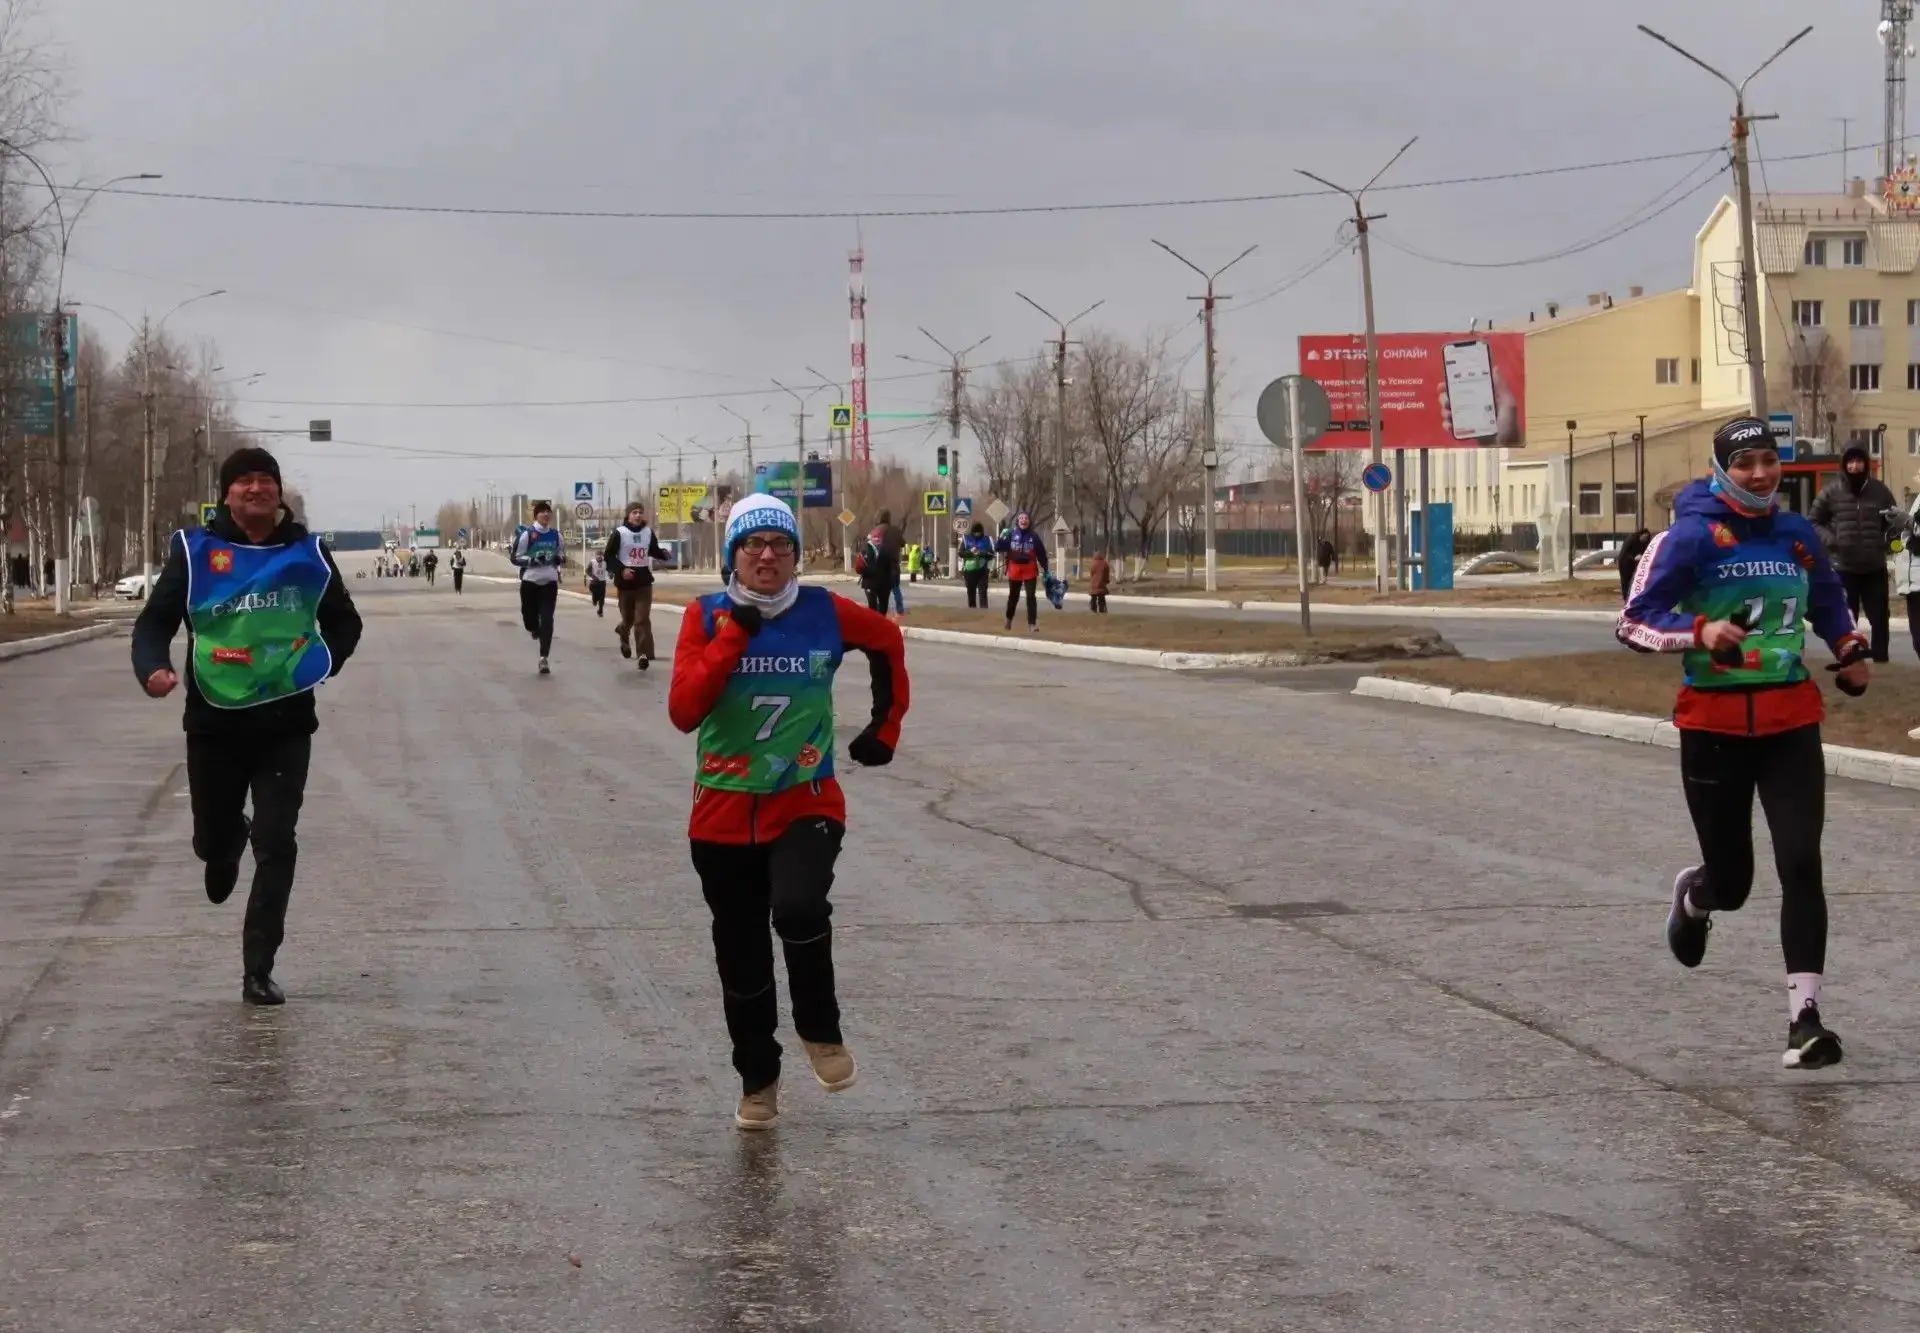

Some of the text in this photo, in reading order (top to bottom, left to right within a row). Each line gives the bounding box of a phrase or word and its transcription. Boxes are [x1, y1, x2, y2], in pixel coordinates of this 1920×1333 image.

[1383, 347, 1427, 359] ОНЛАЙН
[579, 507, 590, 515] 20
[956, 520, 968, 529] 20
[629, 547, 645, 559] 40
[1717, 560, 1799, 579] УСИНСК
[1744, 595, 1798, 636] 11
[733, 656, 806, 674] ИНСК
[750, 695, 791, 741] 7
